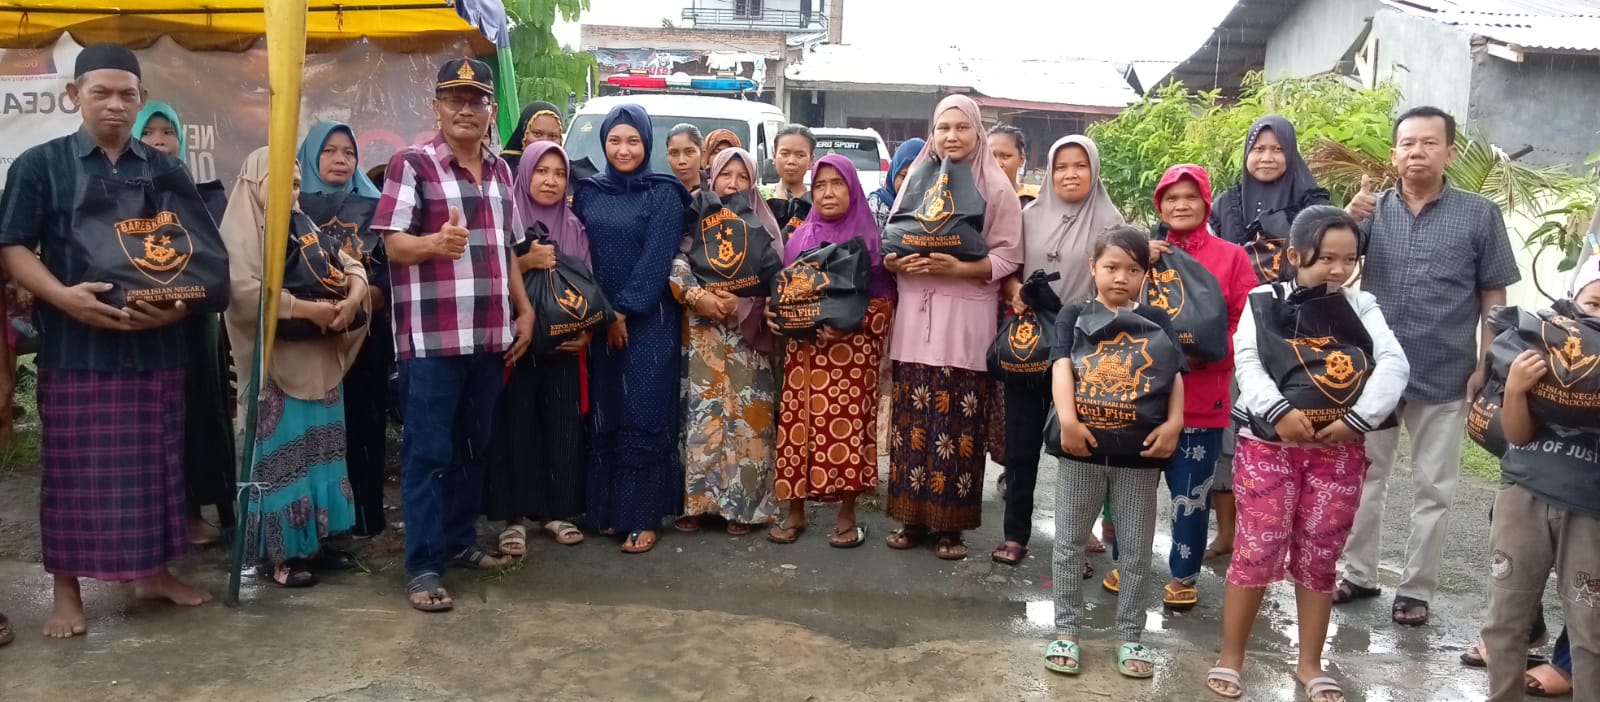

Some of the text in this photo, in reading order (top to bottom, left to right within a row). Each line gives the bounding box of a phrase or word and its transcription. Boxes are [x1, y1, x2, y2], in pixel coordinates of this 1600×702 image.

[834, 141, 860, 149] SPORT
[121, 212, 173, 232] BARESKRIM
[165, 291, 206, 300] INDONESIA
[174, 285, 206, 294] NEGARA
[798, 306, 820, 318] Fitri
[1104, 407, 1136, 420] Fitri
[1542, 440, 1564, 454] OF
